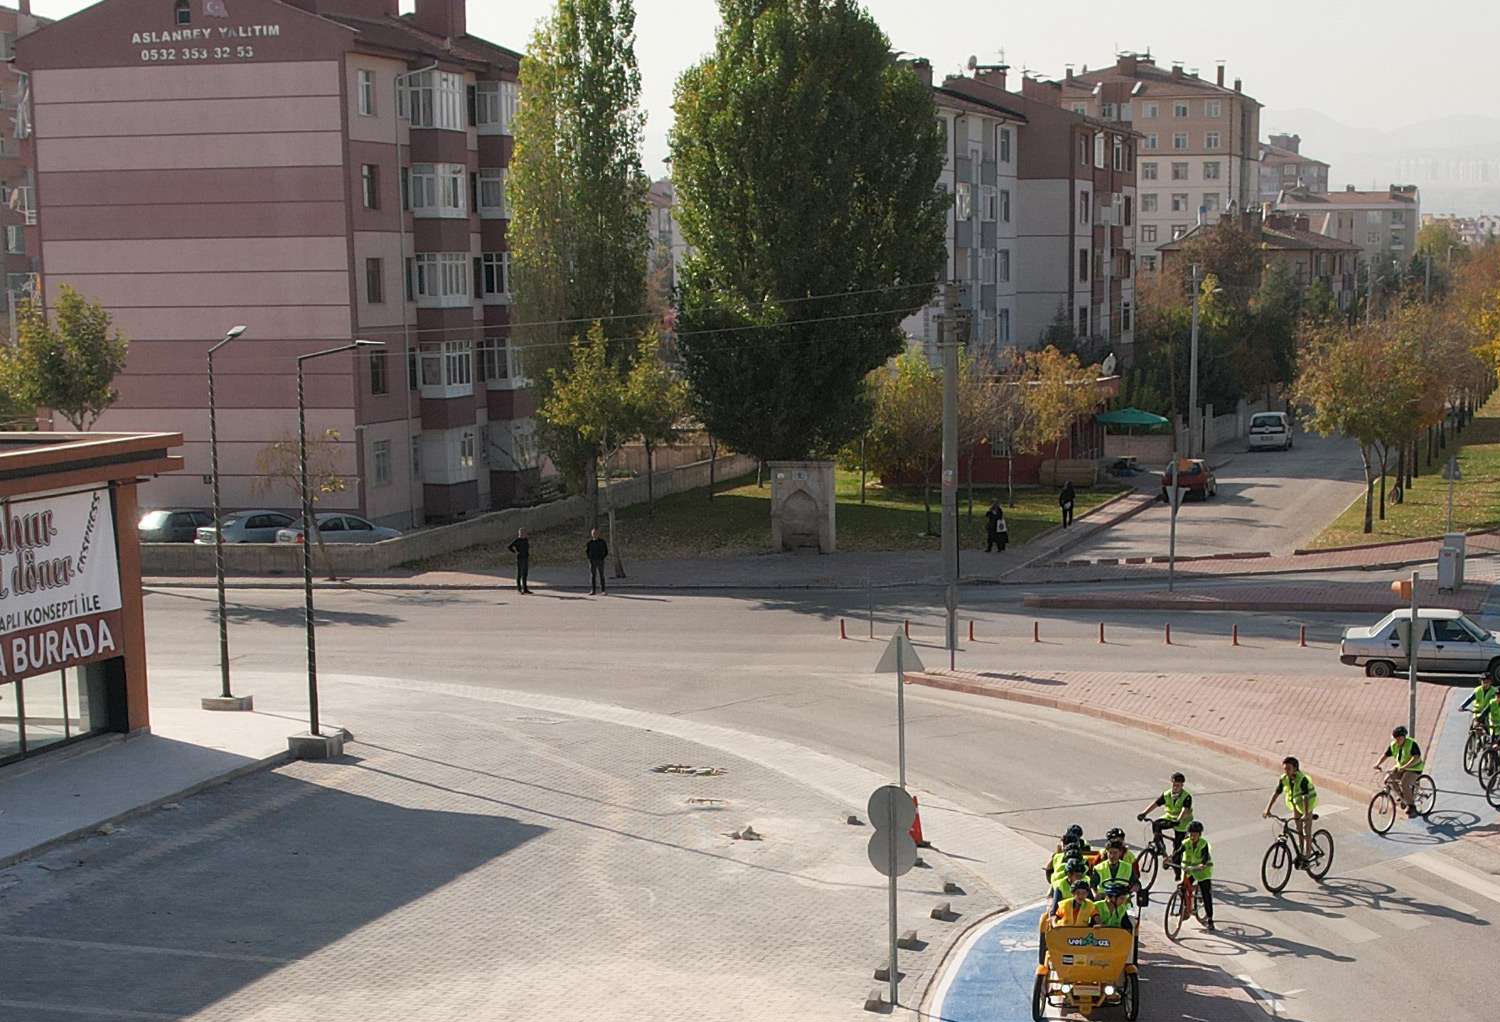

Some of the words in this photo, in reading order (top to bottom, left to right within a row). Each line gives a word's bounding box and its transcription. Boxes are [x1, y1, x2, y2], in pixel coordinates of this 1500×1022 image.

[218, 25, 280, 38] YALITIM
[141, 49, 176, 61] 0532
[182, 48, 208, 60] 353
[214, 47, 231, 58] 32
[236, 46, 254, 58] 53
[11, 550, 76, 597] döner
[24, 594, 79, 626] KONSEPTİ
[81, 593, 101, 613] İLE
[12, 618, 115, 674] BURADA
